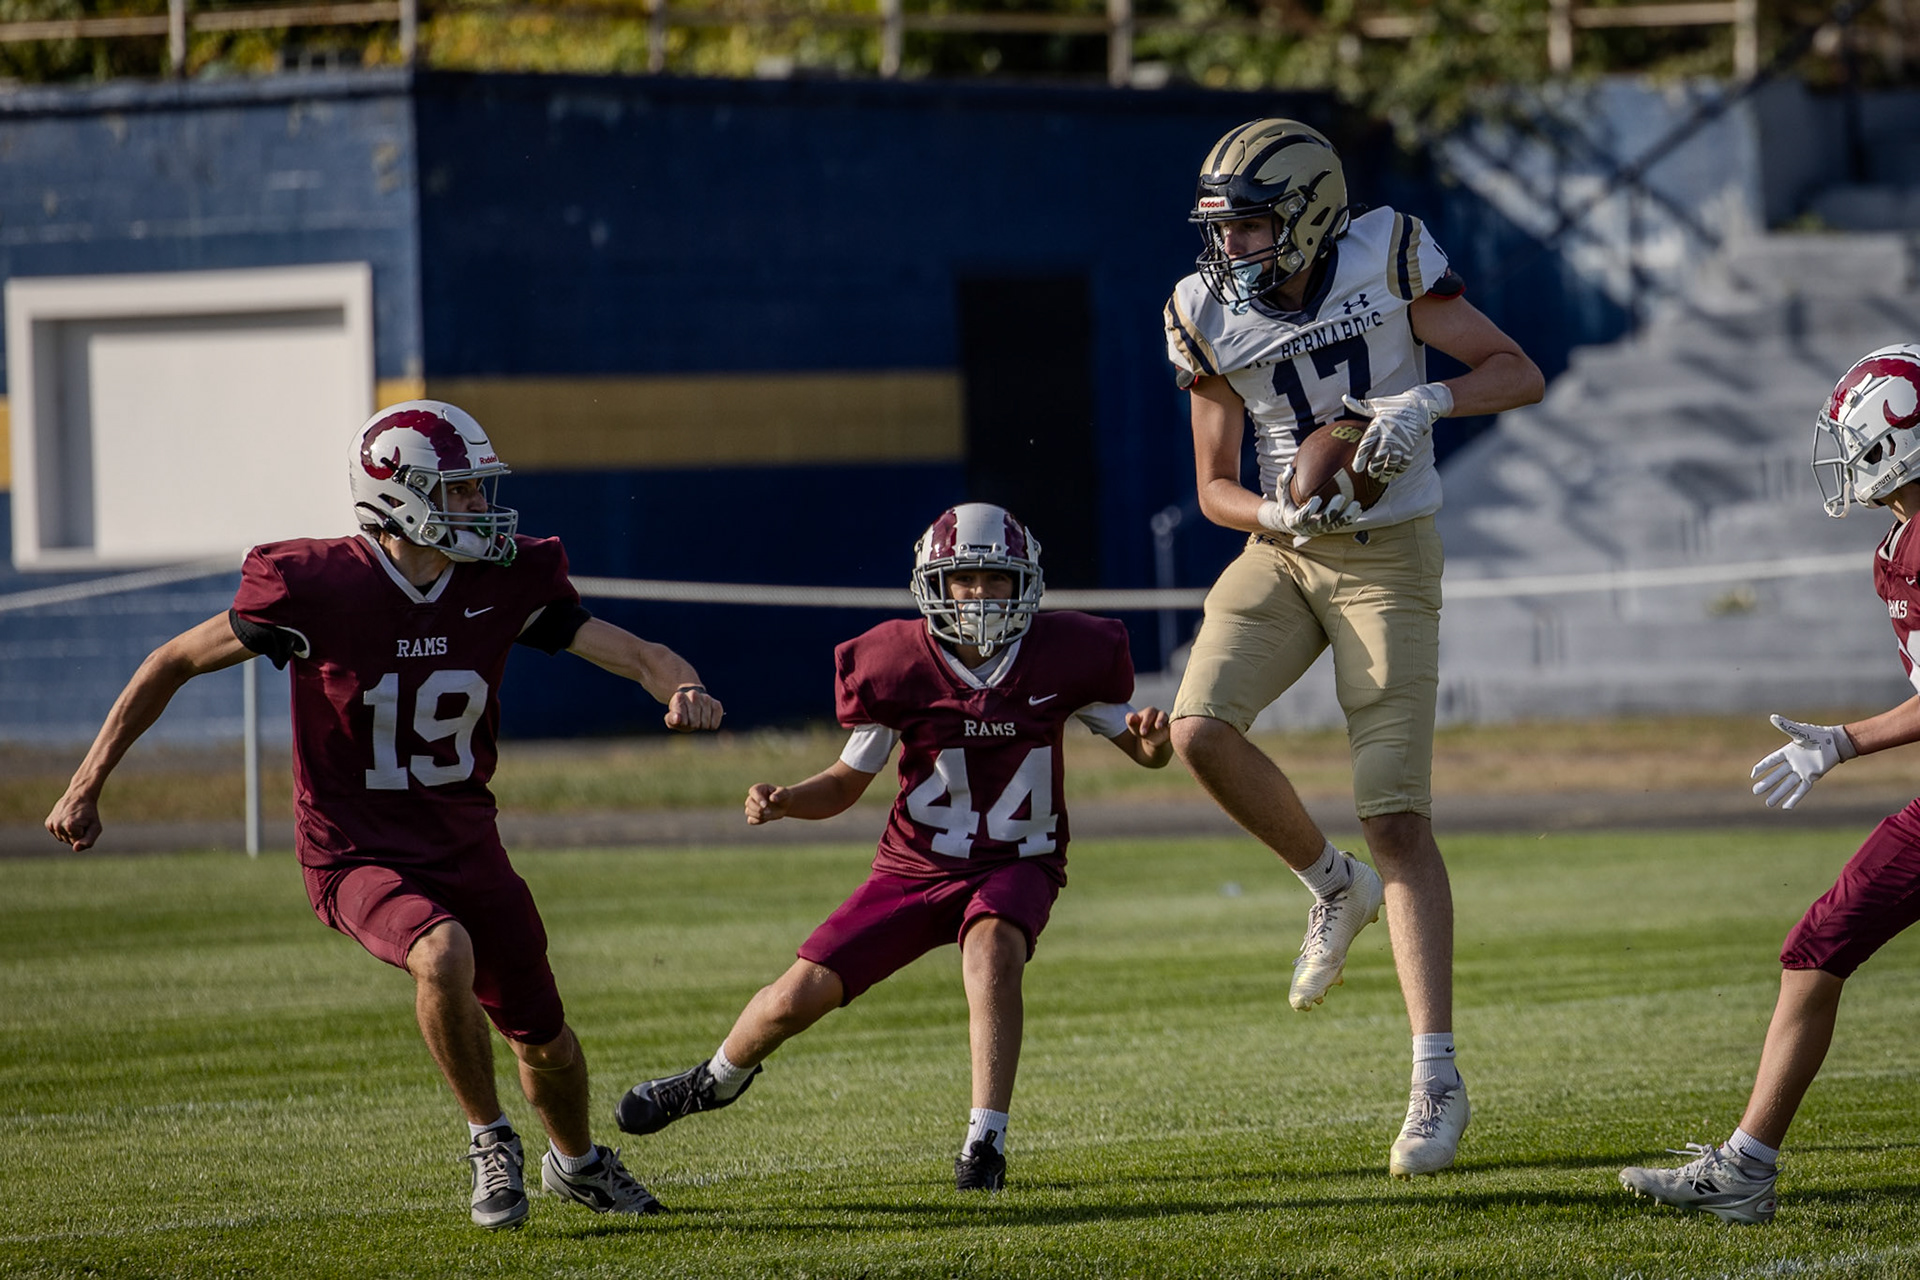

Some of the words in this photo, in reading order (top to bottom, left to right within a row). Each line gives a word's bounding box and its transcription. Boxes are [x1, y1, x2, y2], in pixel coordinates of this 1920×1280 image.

[1272, 334, 1371, 447] 17
[396, 636, 448, 658] RAMS
[363, 670, 489, 790] 19
[963, 719, 1017, 737] RAMS
[906, 745, 1058, 859] 44
